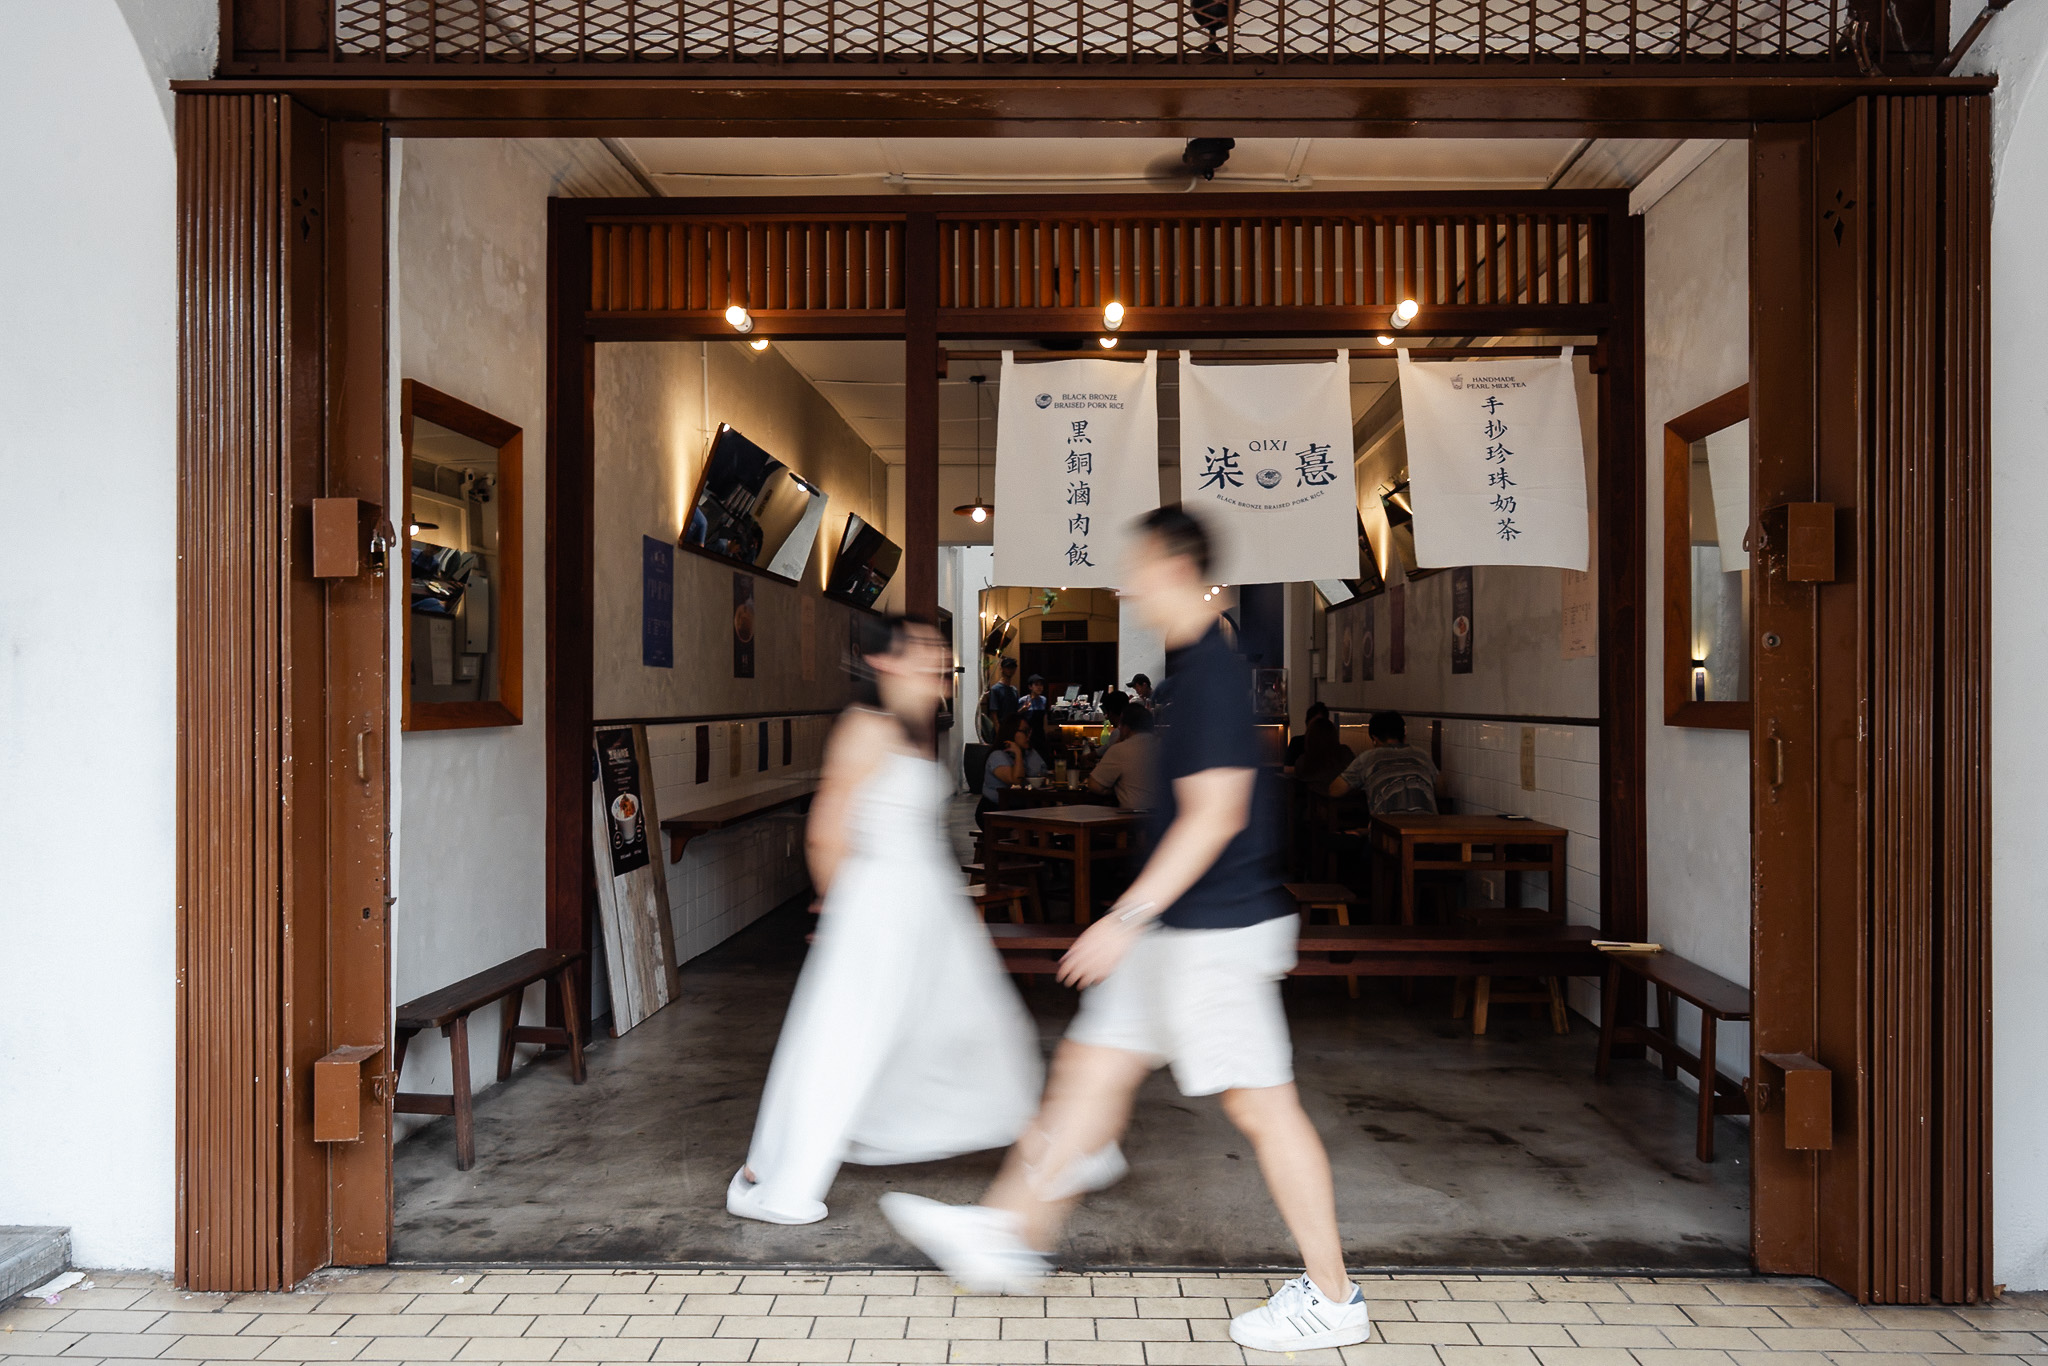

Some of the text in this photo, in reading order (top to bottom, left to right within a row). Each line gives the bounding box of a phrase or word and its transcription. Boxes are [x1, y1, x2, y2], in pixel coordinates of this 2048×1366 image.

[1089, 393, 1118, 401] BRONZE
[1109, 402, 1124, 410] RICE
[1248, 439, 1288, 452] QIXI
[1198, 446, 1244, 491] 柒
[1481, 395, 1522, 541] 手抄珍珠奶茶
[1064, 419, 1095, 567] 黑銅滷肉飯
[1216, 489, 1325, 510] BLACK BRONZE BRAISED PORK RICE
